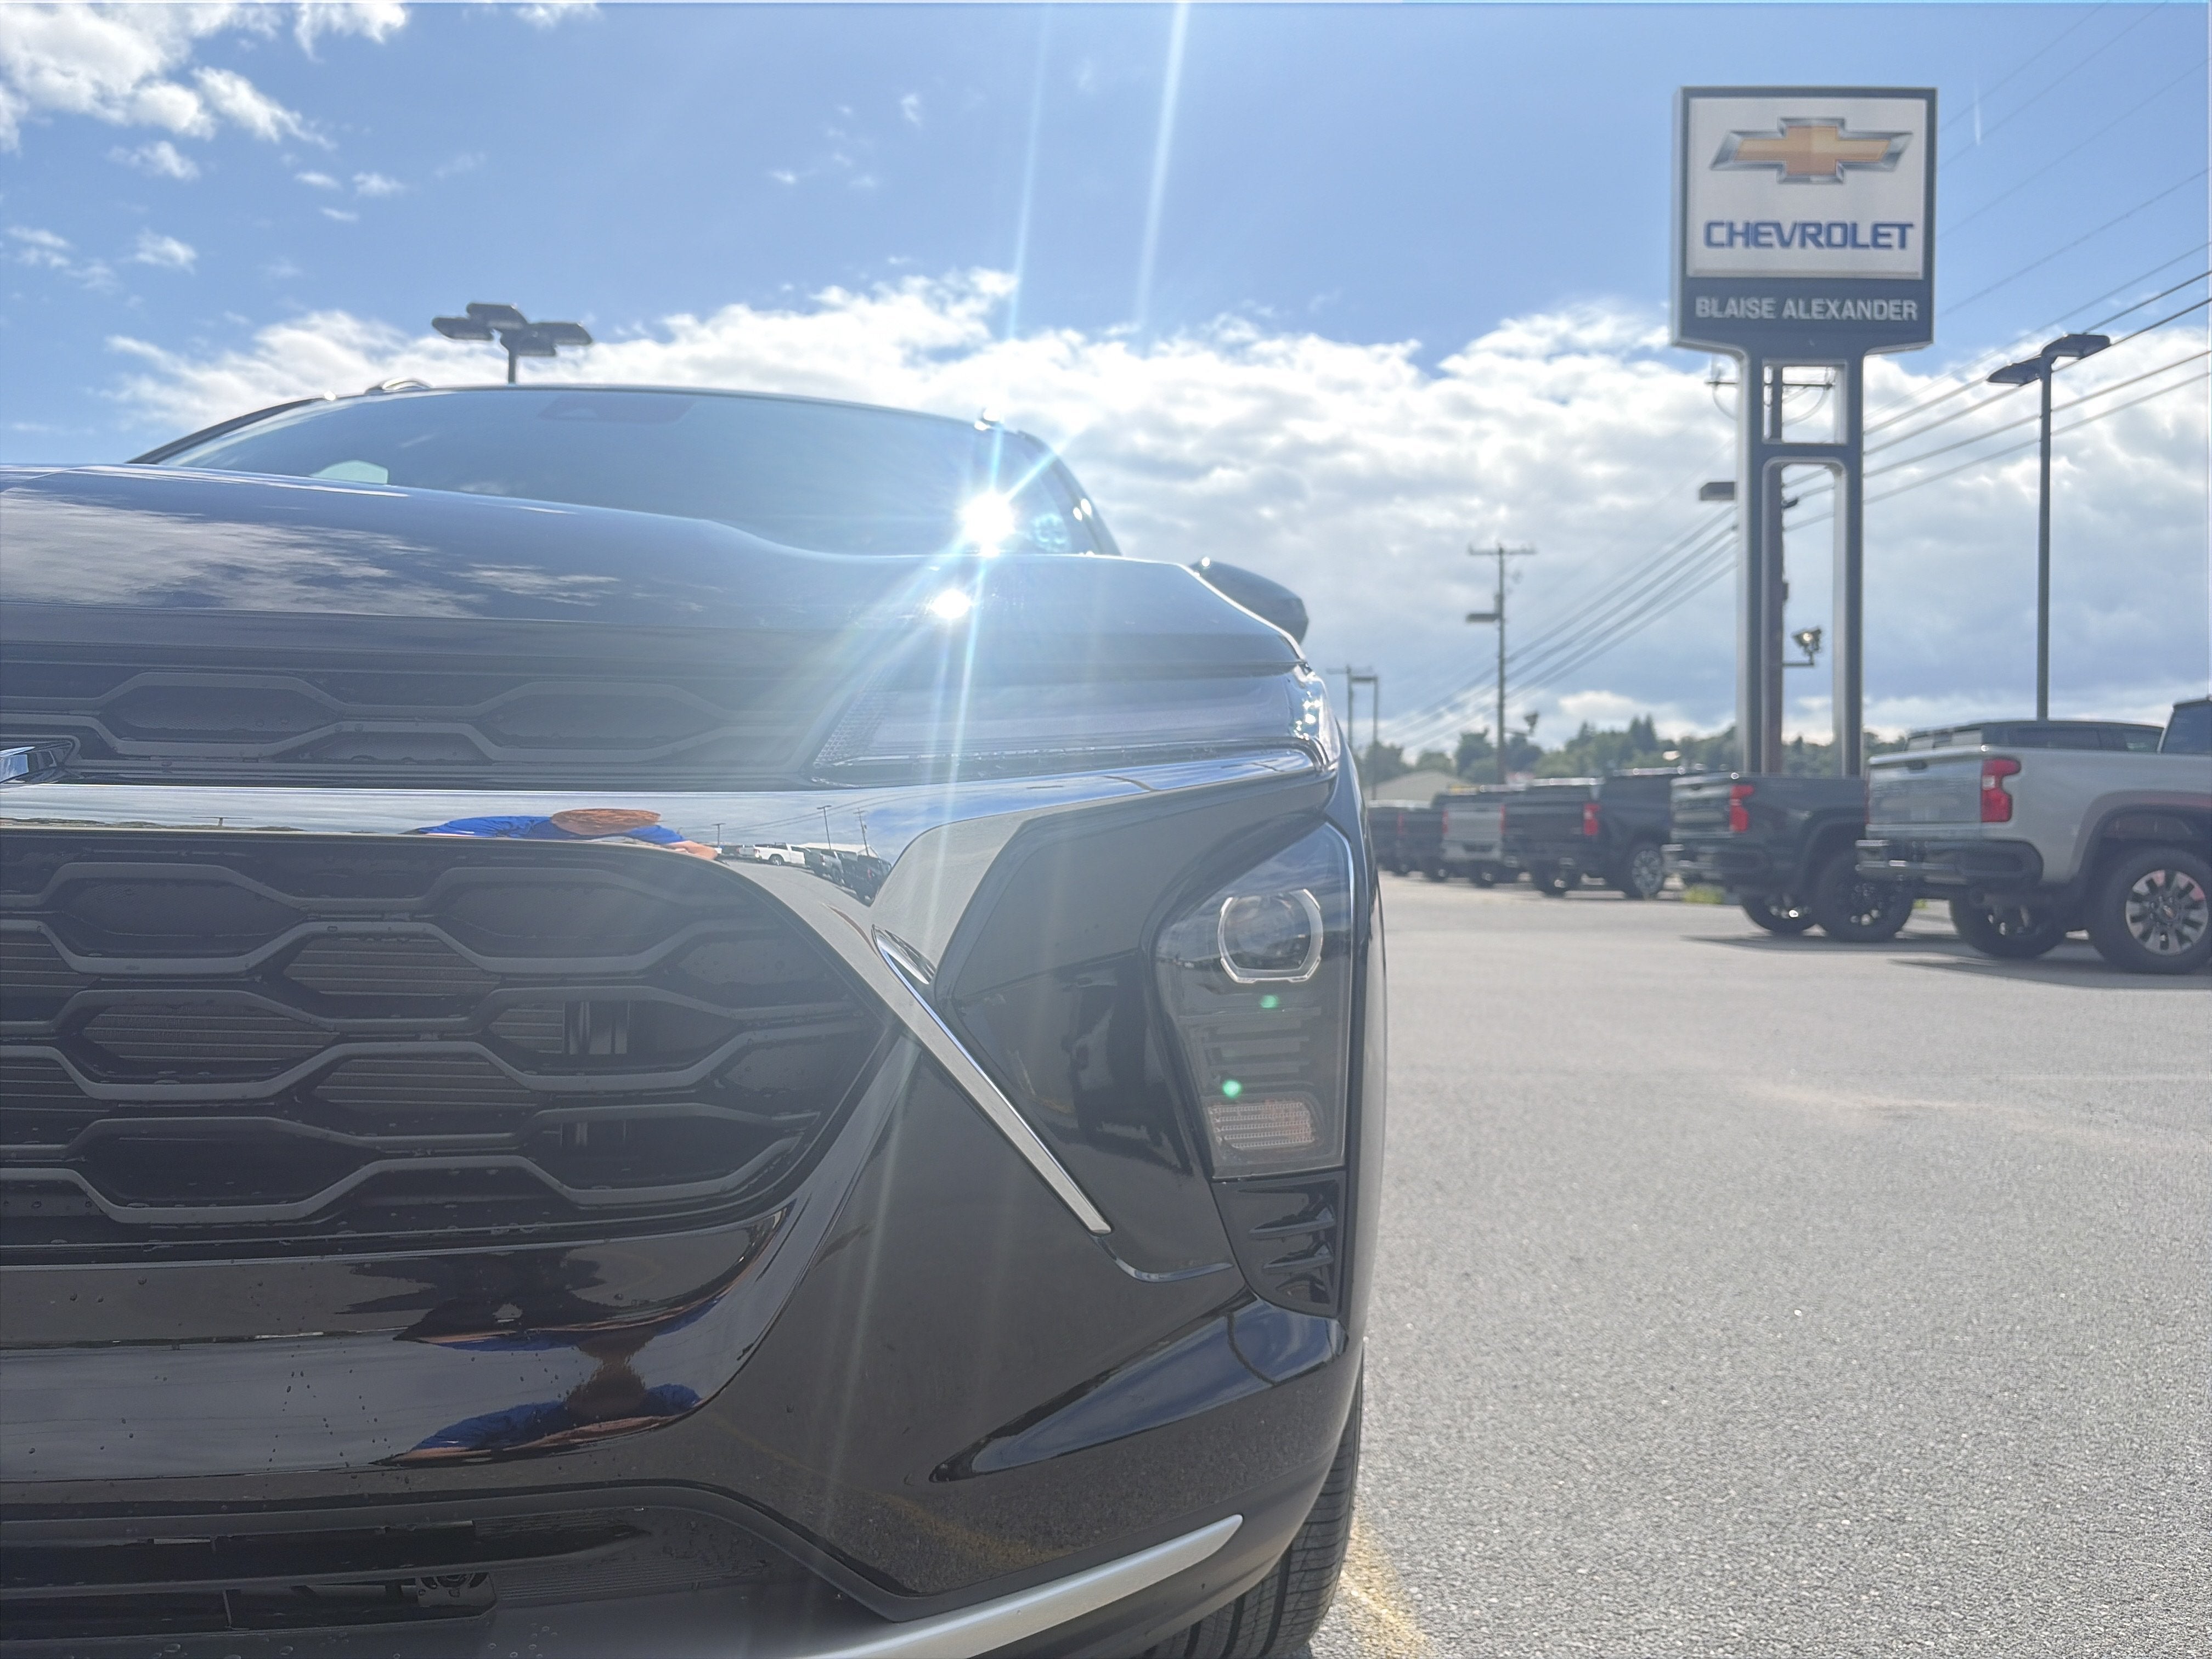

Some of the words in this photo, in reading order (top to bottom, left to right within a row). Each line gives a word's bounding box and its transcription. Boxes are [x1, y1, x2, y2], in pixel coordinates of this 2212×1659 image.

[1703, 221, 1914, 250] CHEVROLET
[1695, 297, 1776, 319] BLAISE
[1782, 298, 1918, 321] ALEXANDER
